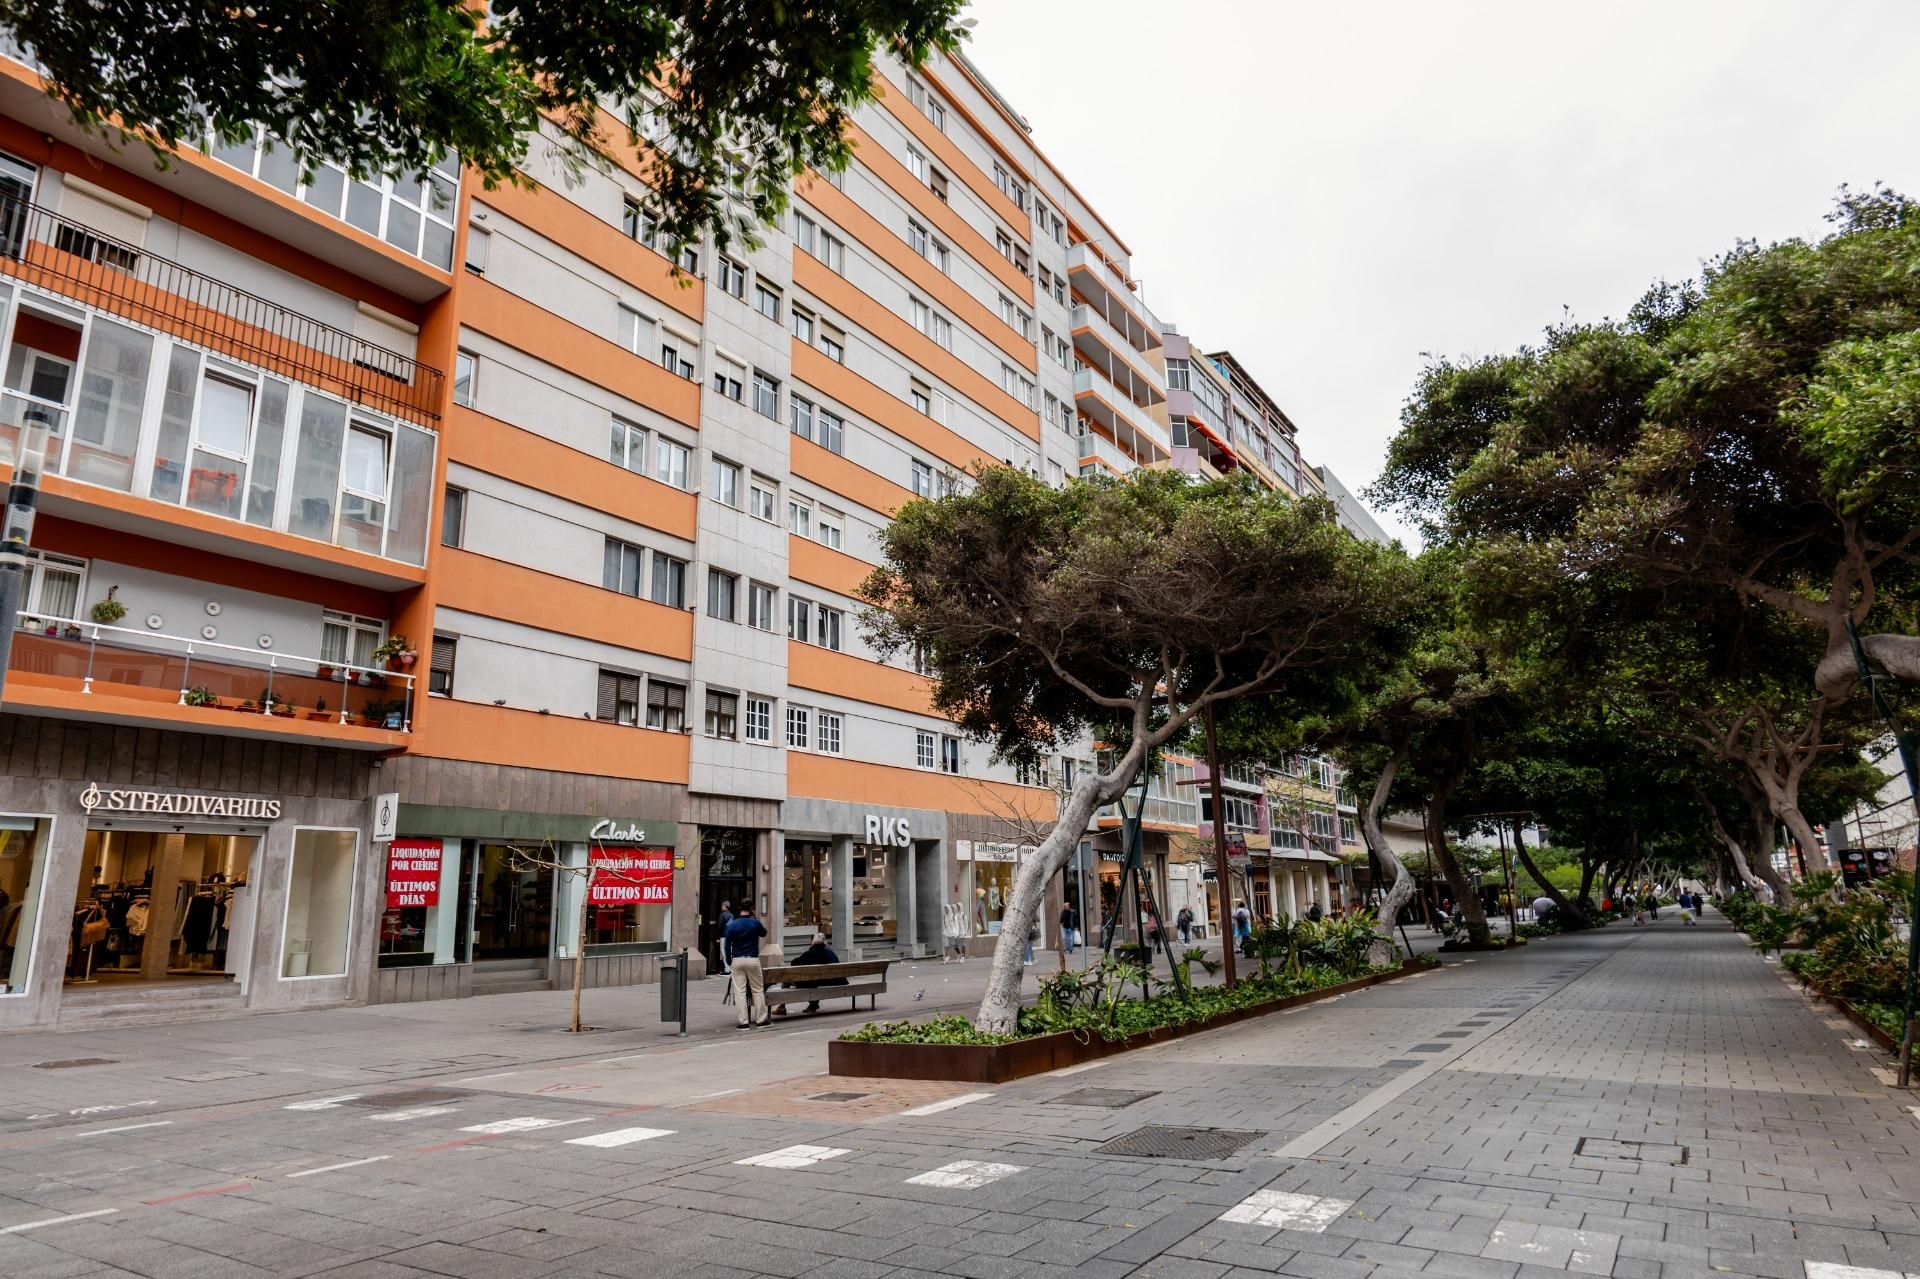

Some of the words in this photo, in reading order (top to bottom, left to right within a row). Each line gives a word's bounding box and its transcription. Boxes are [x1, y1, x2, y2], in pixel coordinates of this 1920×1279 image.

[107, 790, 281, 818] STRADIVARIUS
[589, 819, 645, 841] Clarks
[865, 814, 911, 848] RKS
[391, 846, 441, 859] LIQUIDACIÓN
[391, 860, 409, 871] POR
[634, 859, 648, 869] POR
[649, 859, 671, 869] CIERRE
[390, 879, 436, 892] ÚLTIMOS
[592, 884, 640, 900] ÚLTIMOS
[643, 884, 669, 900] DÍAS
[399, 892, 425, 905] DÍAS
